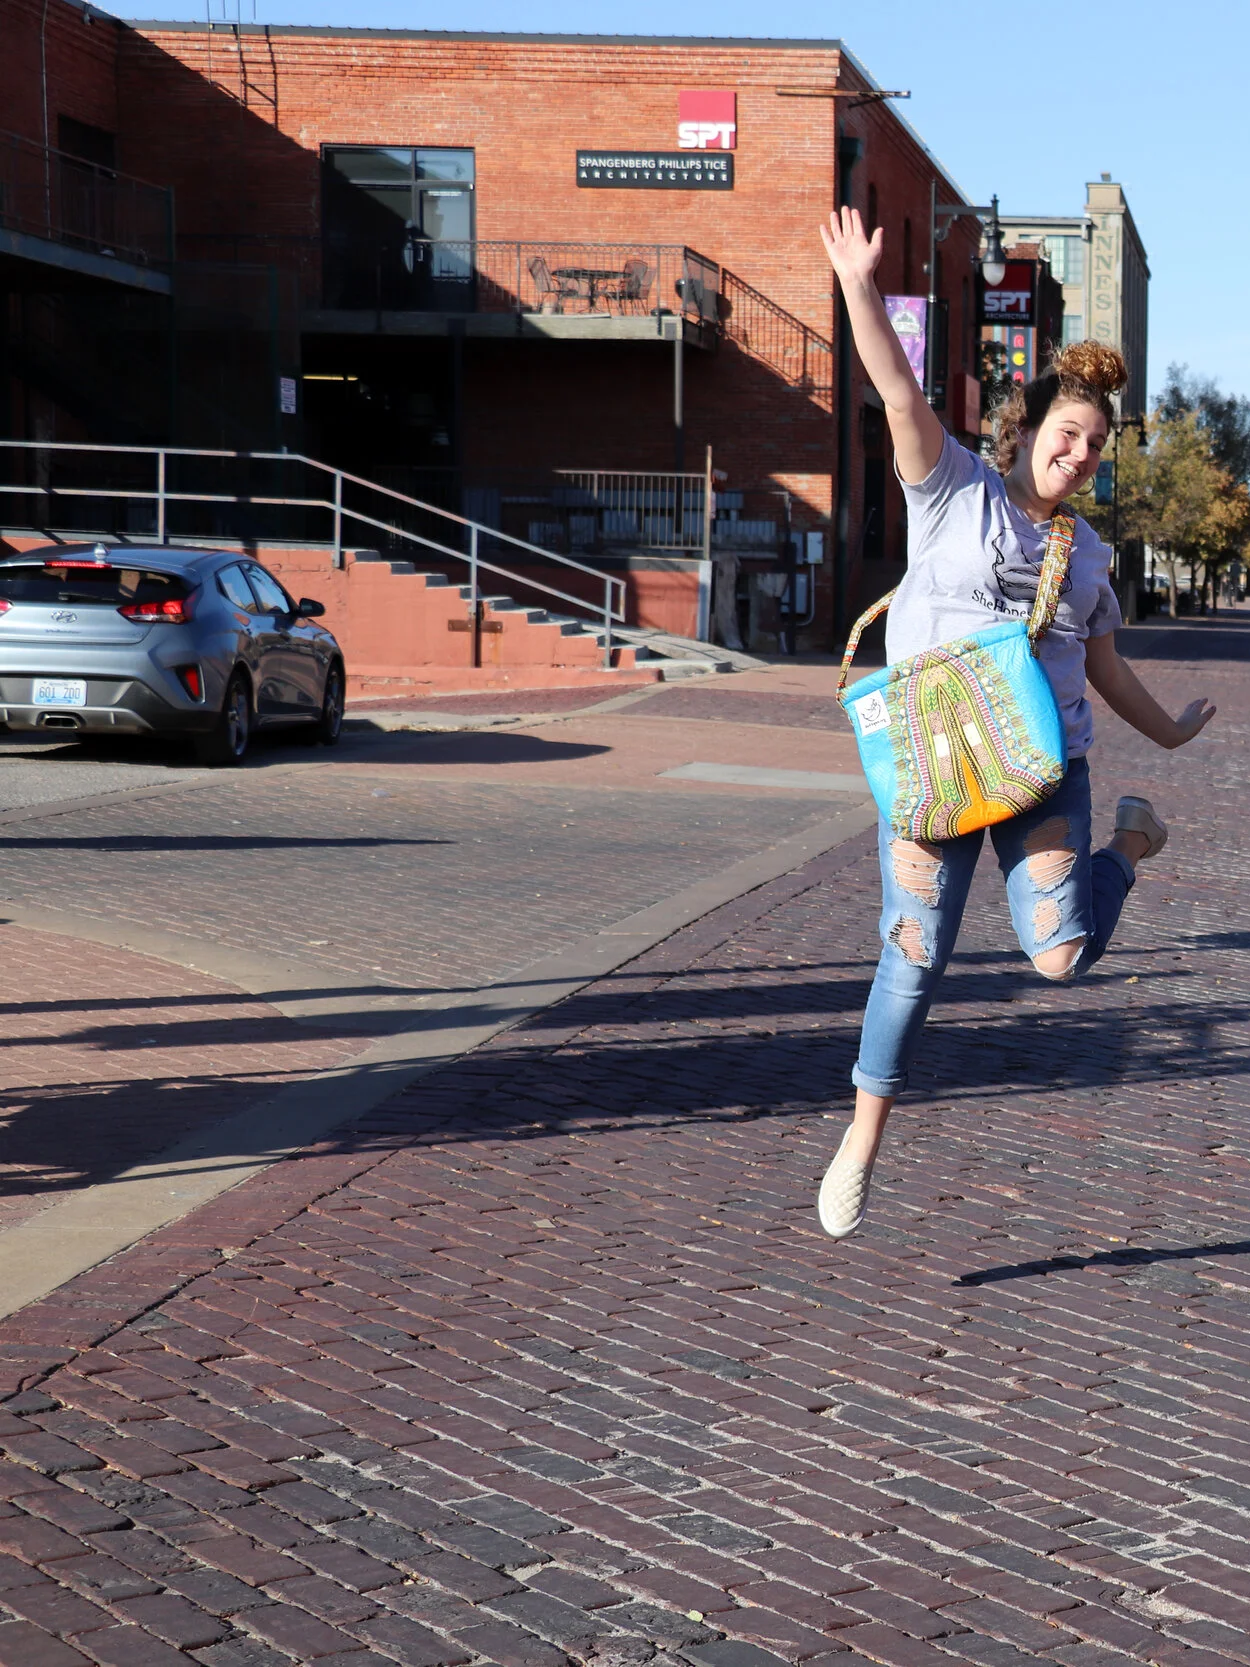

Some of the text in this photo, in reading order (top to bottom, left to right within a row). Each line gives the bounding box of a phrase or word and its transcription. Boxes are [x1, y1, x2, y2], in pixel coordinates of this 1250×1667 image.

[678, 122, 736, 149] SPT
[579, 158, 727, 170] SPANGENBERG PHILLIPS TICE
[579, 170, 728, 182] ARCHITECTURE
[1095, 215, 1114, 311] INNES
[984, 291, 1031, 313] SPT
[39, 686, 57, 699] 601
